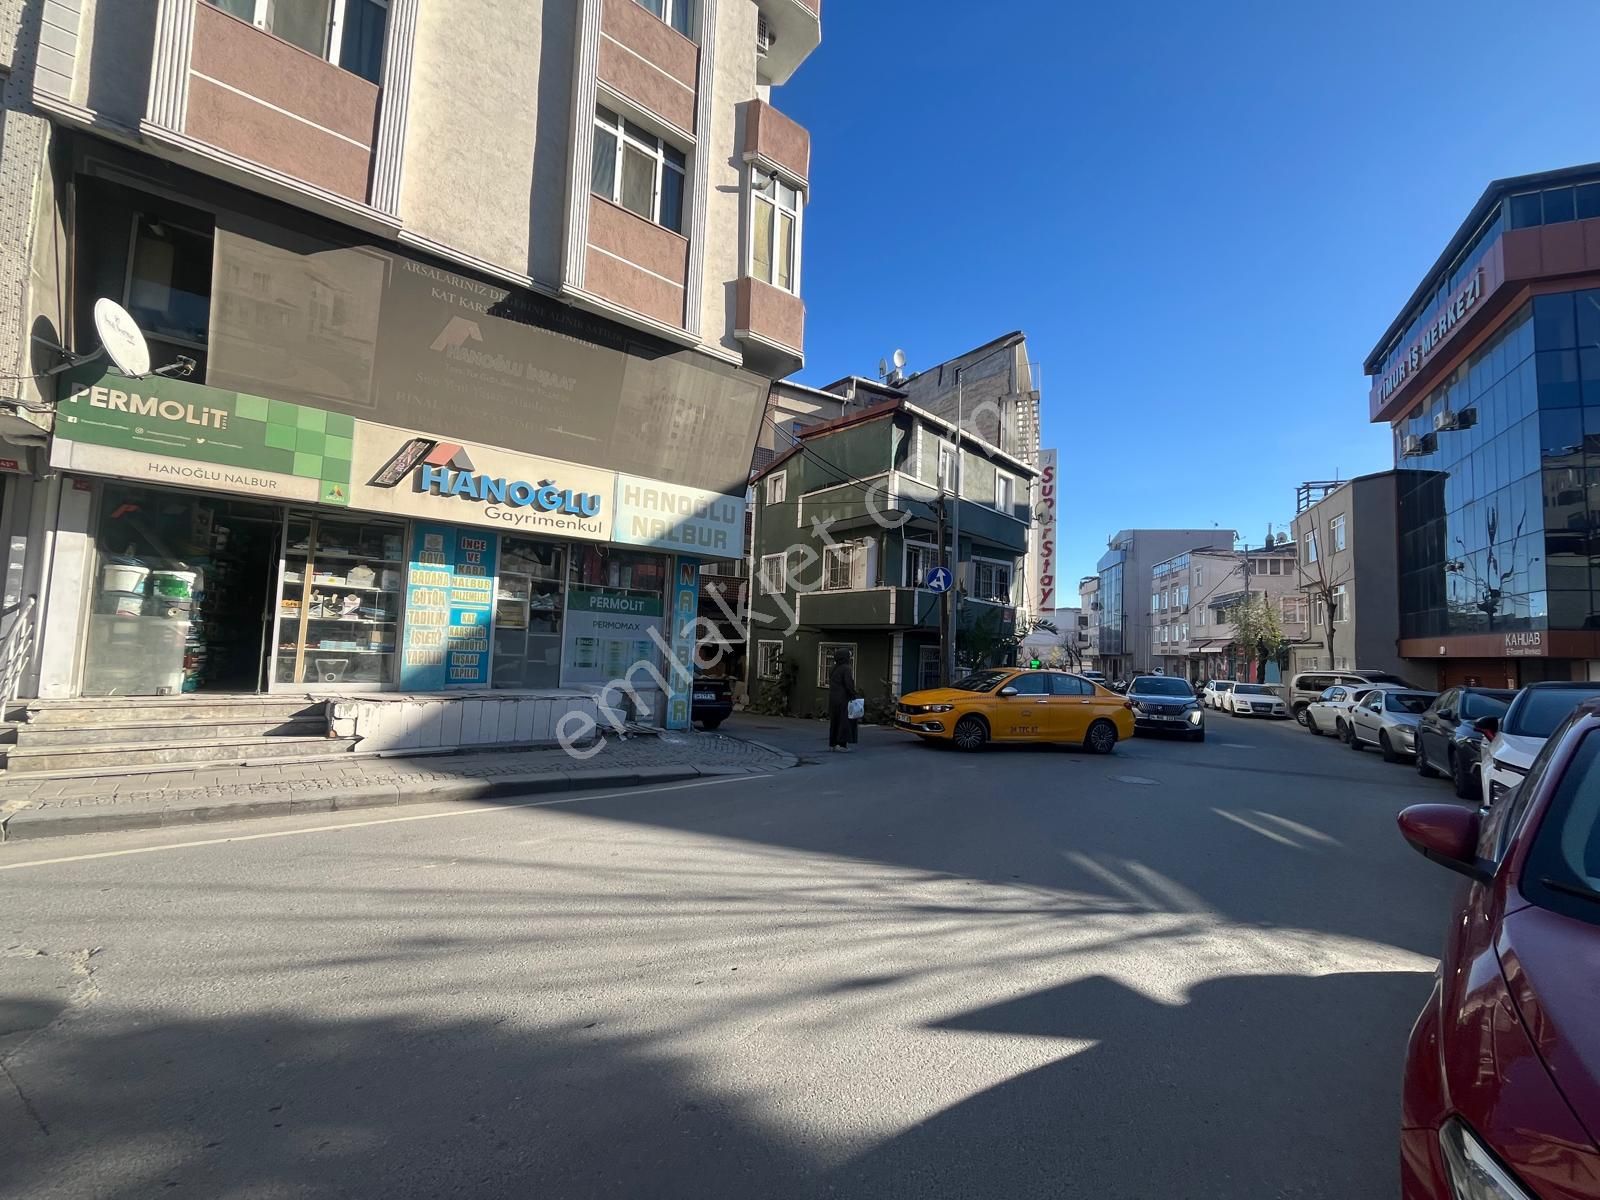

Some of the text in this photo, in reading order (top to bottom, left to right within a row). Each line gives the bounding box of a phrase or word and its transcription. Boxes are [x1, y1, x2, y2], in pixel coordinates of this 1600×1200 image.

[431, 287, 456, 303] KAT
[1420, 267, 1484, 358] MERKEZİ
[148, 462, 278, 489] HANOĞLU NALBUR
[418, 463, 602, 519] HANOĞLU
[623, 483, 736, 525] HANOĞLU
[484, 505, 603, 534] Gayrimenkul
[631, 515, 728, 550] NALBUR
[419, 551, 445, 566] BOYA
[466, 552, 480, 563] VE
[410, 570, 450, 587] BADANA
[457, 564, 486, 577] KABA
[450, 577, 492, 589] NALBUR
[412, 587, 446, 608] BÜTÜN
[461, 613, 477, 624] KAT
[592, 620, 641, 631] PERMOMAX
[671, 563, 696, 722] NALBUR
[450, 668, 479, 679] YAPILIR
